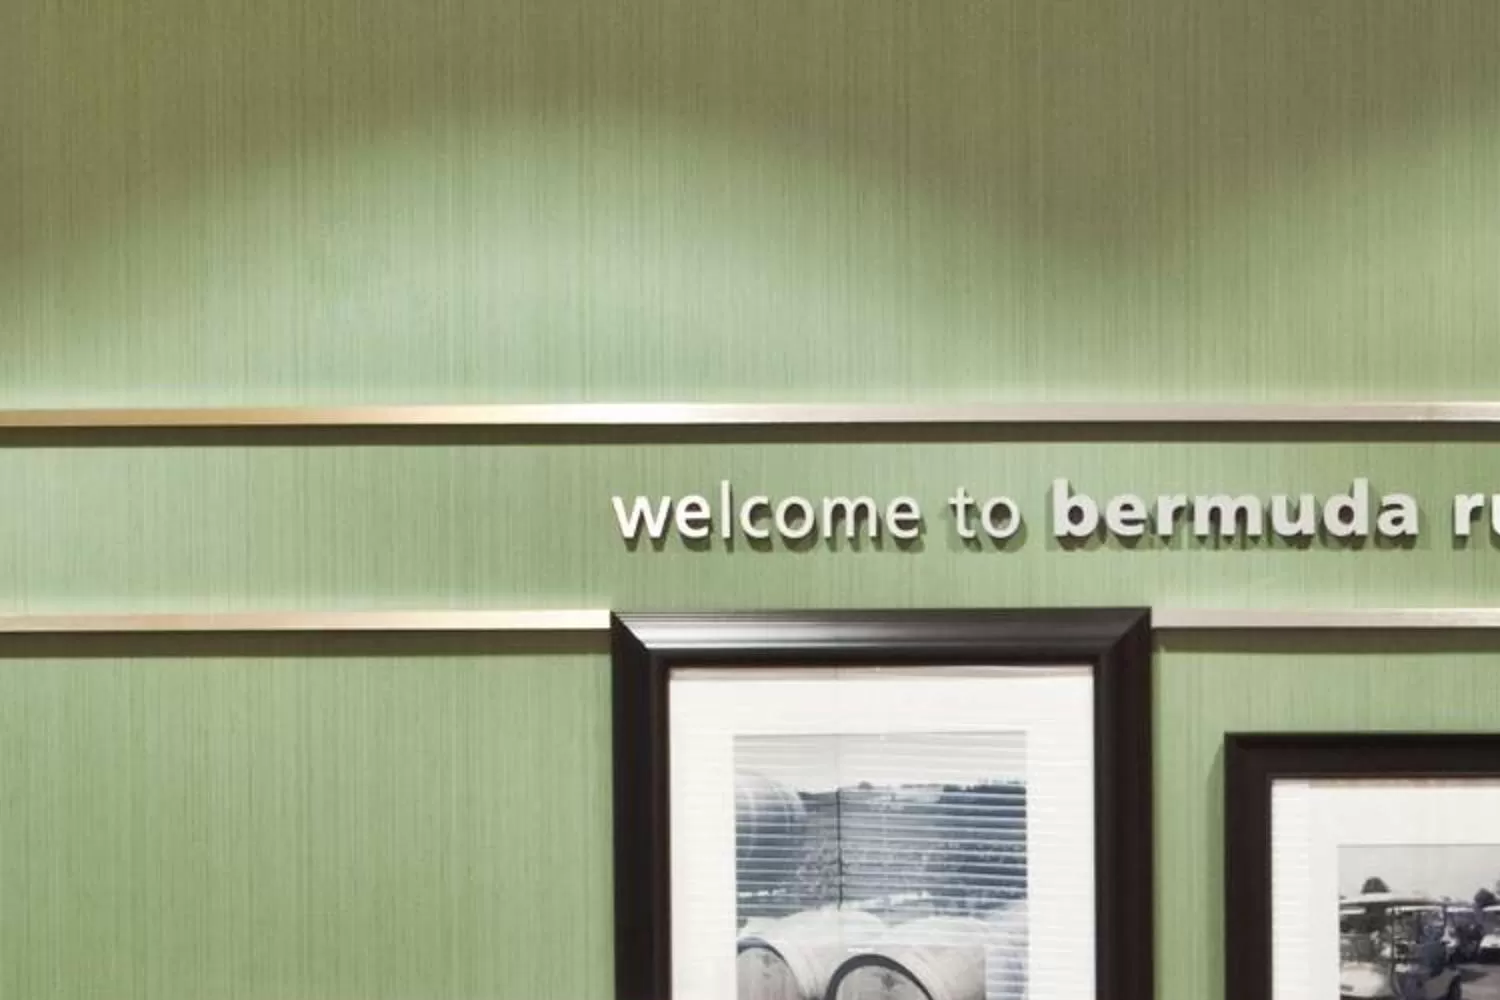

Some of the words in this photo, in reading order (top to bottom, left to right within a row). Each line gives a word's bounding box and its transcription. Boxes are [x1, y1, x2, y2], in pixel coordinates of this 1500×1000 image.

[612, 479, 922, 539] welcome
[948, 486, 1021, 539] to
[1052, 478, 1419, 536] bermuda
